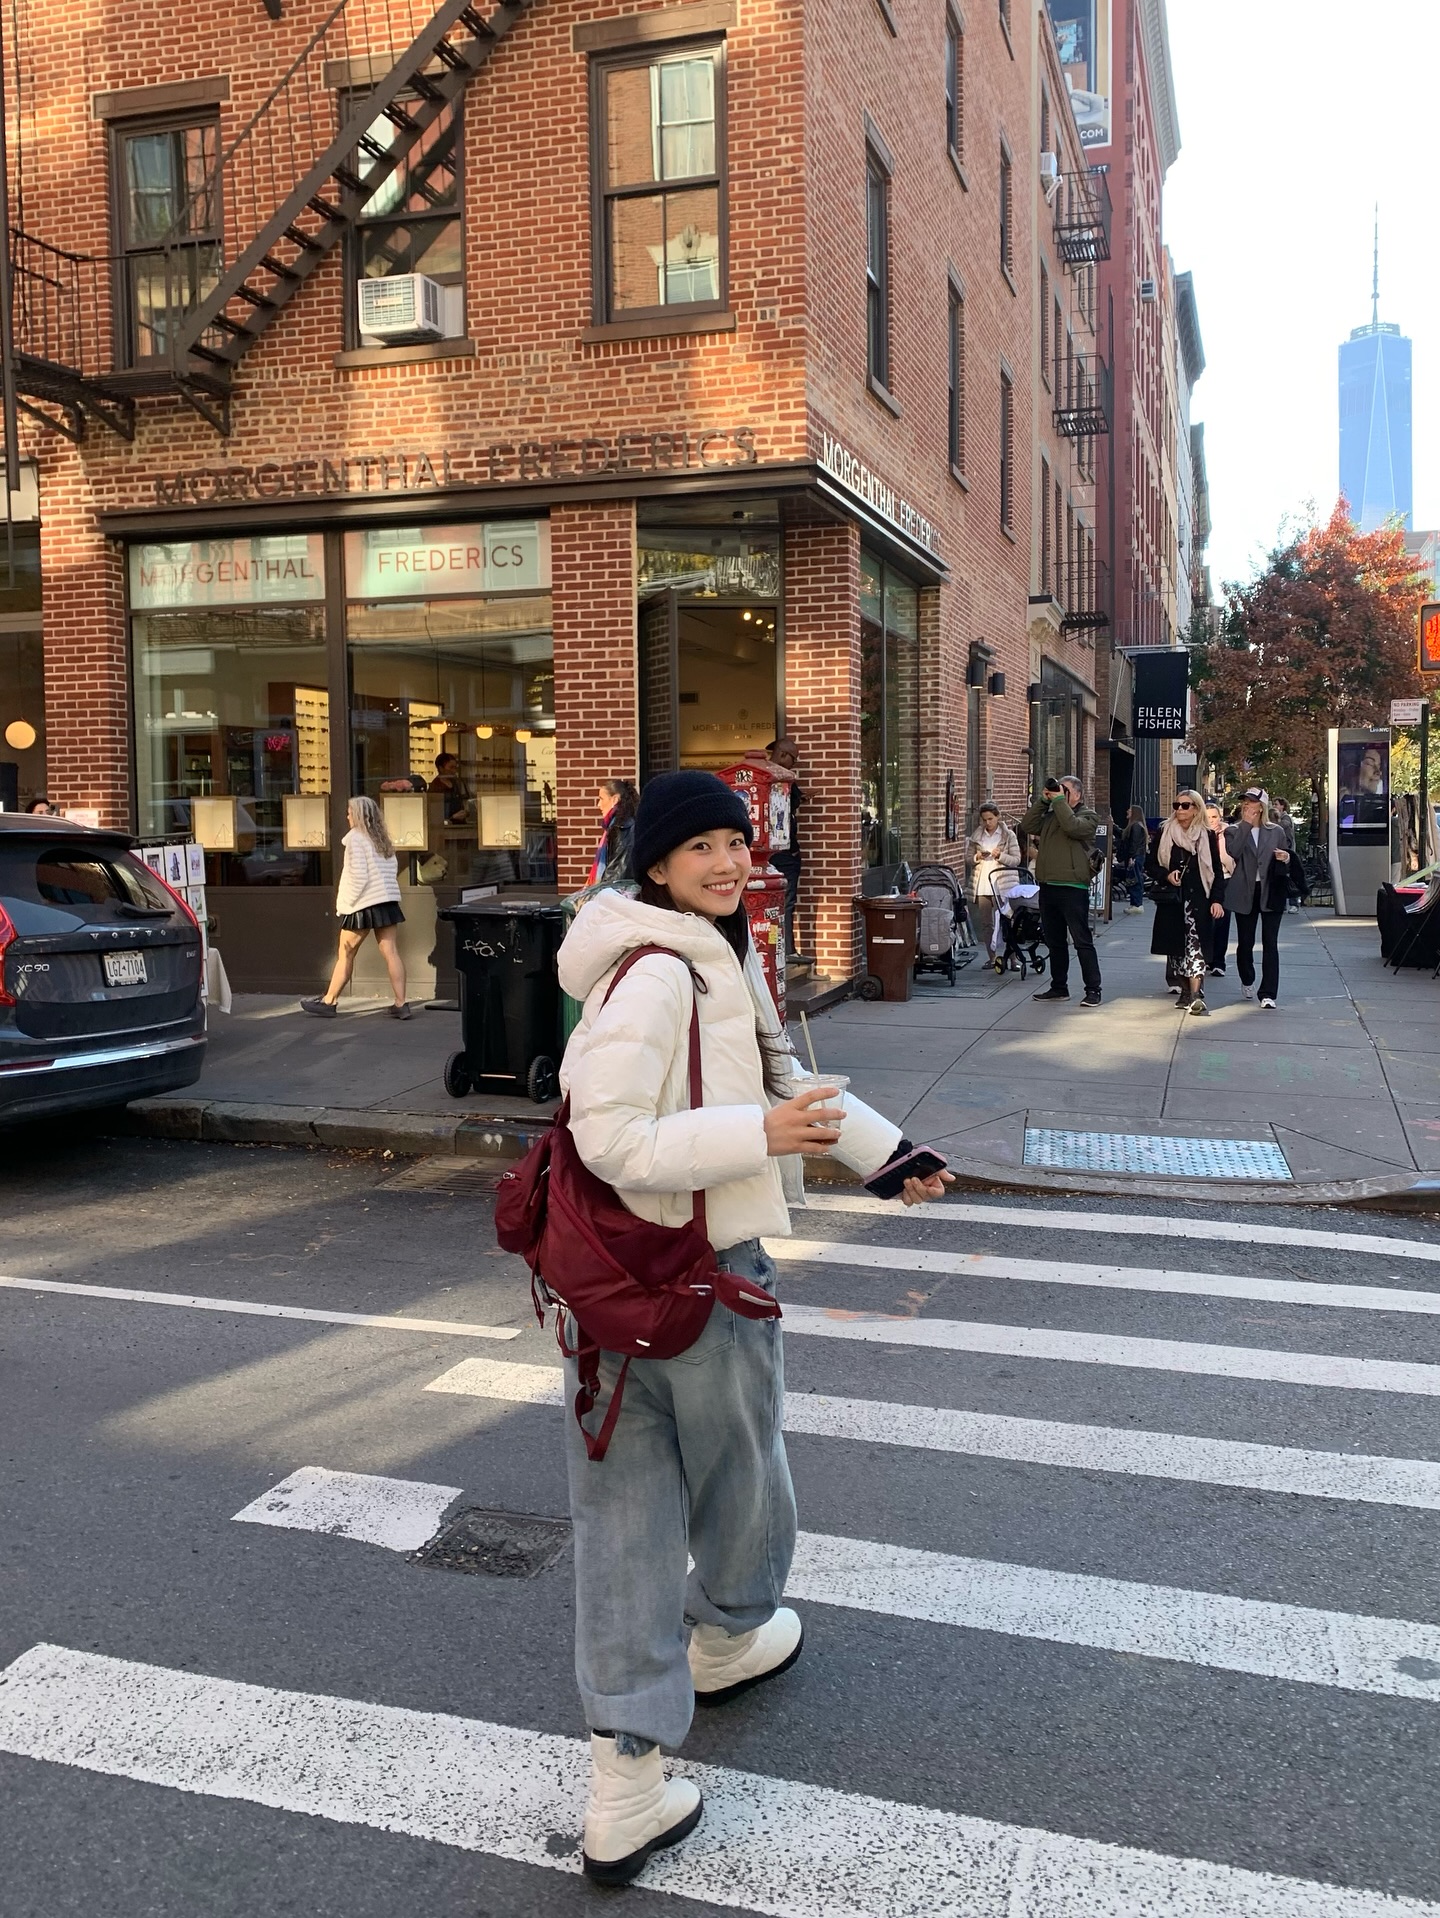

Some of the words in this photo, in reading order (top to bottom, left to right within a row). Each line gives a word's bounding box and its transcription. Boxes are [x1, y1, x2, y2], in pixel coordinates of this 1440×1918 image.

[155, 450, 467, 505] MORGENTHAL
[489, 426, 758, 481] FREDERICS
[823, 431, 896, 520] MORGENTHAL
[378, 545, 523, 574] FREDERICS
[1138, 707, 1182, 718] EILEEN
[1138, 719, 1181, 729] FISHER
[90, 929, 167, 940] VOLVO
[16, 963, 50, 973] XC90
